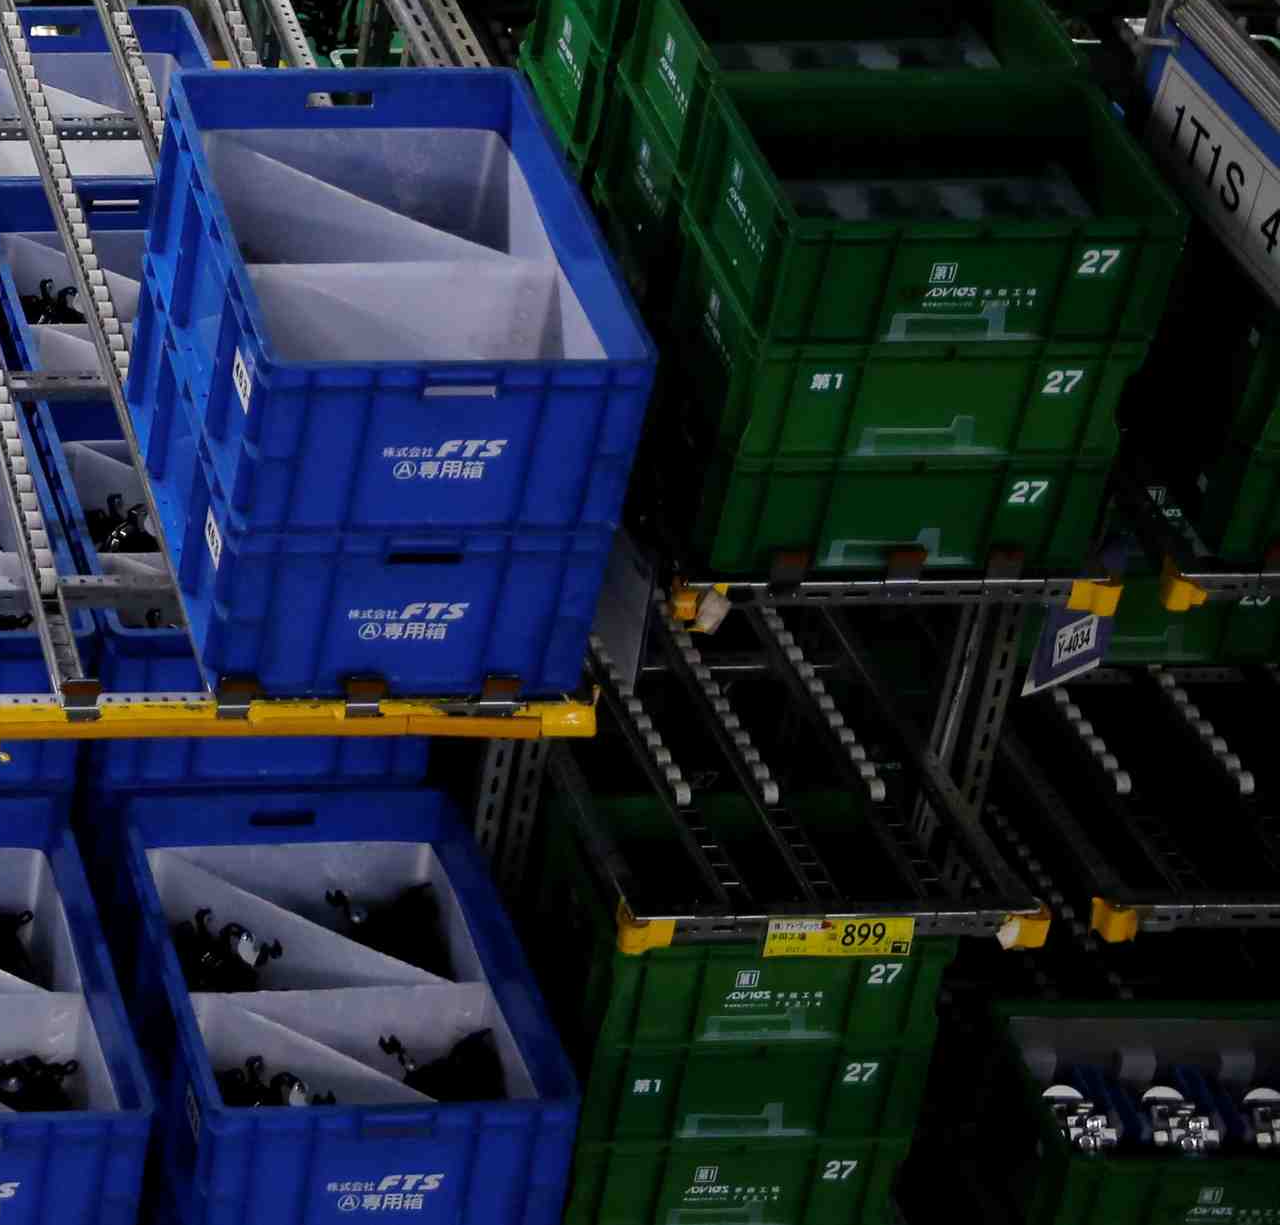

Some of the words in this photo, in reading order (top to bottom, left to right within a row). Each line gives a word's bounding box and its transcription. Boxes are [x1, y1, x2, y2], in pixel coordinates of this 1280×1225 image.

[1170, 104, 1245, 213] 1T1S
[1077, 249, 1120, 274] 27
[810, 373, 844, 390] 第1
[1042, 370, 1083, 393] 27
[383, 446, 433, 458] 株式会社
[436, 439, 508, 457] FTS
[1007, 481, 1048, 503] 27
[348, 608, 397, 620] 株式会社
[399, 602, 471, 620] FTS
[1058, 629, 1090, 659] Y-4034
[841, 923, 886, 947] 899
[867, 963, 904, 984] 27
[843, 1062, 879, 1082] 27
[633, 1079, 661, 1093] 第1
[822, 1160, 858, 1180] 27
[327, 1181, 374, 1192] 株式会社
[377, 1174, 444, 1191] FTS
